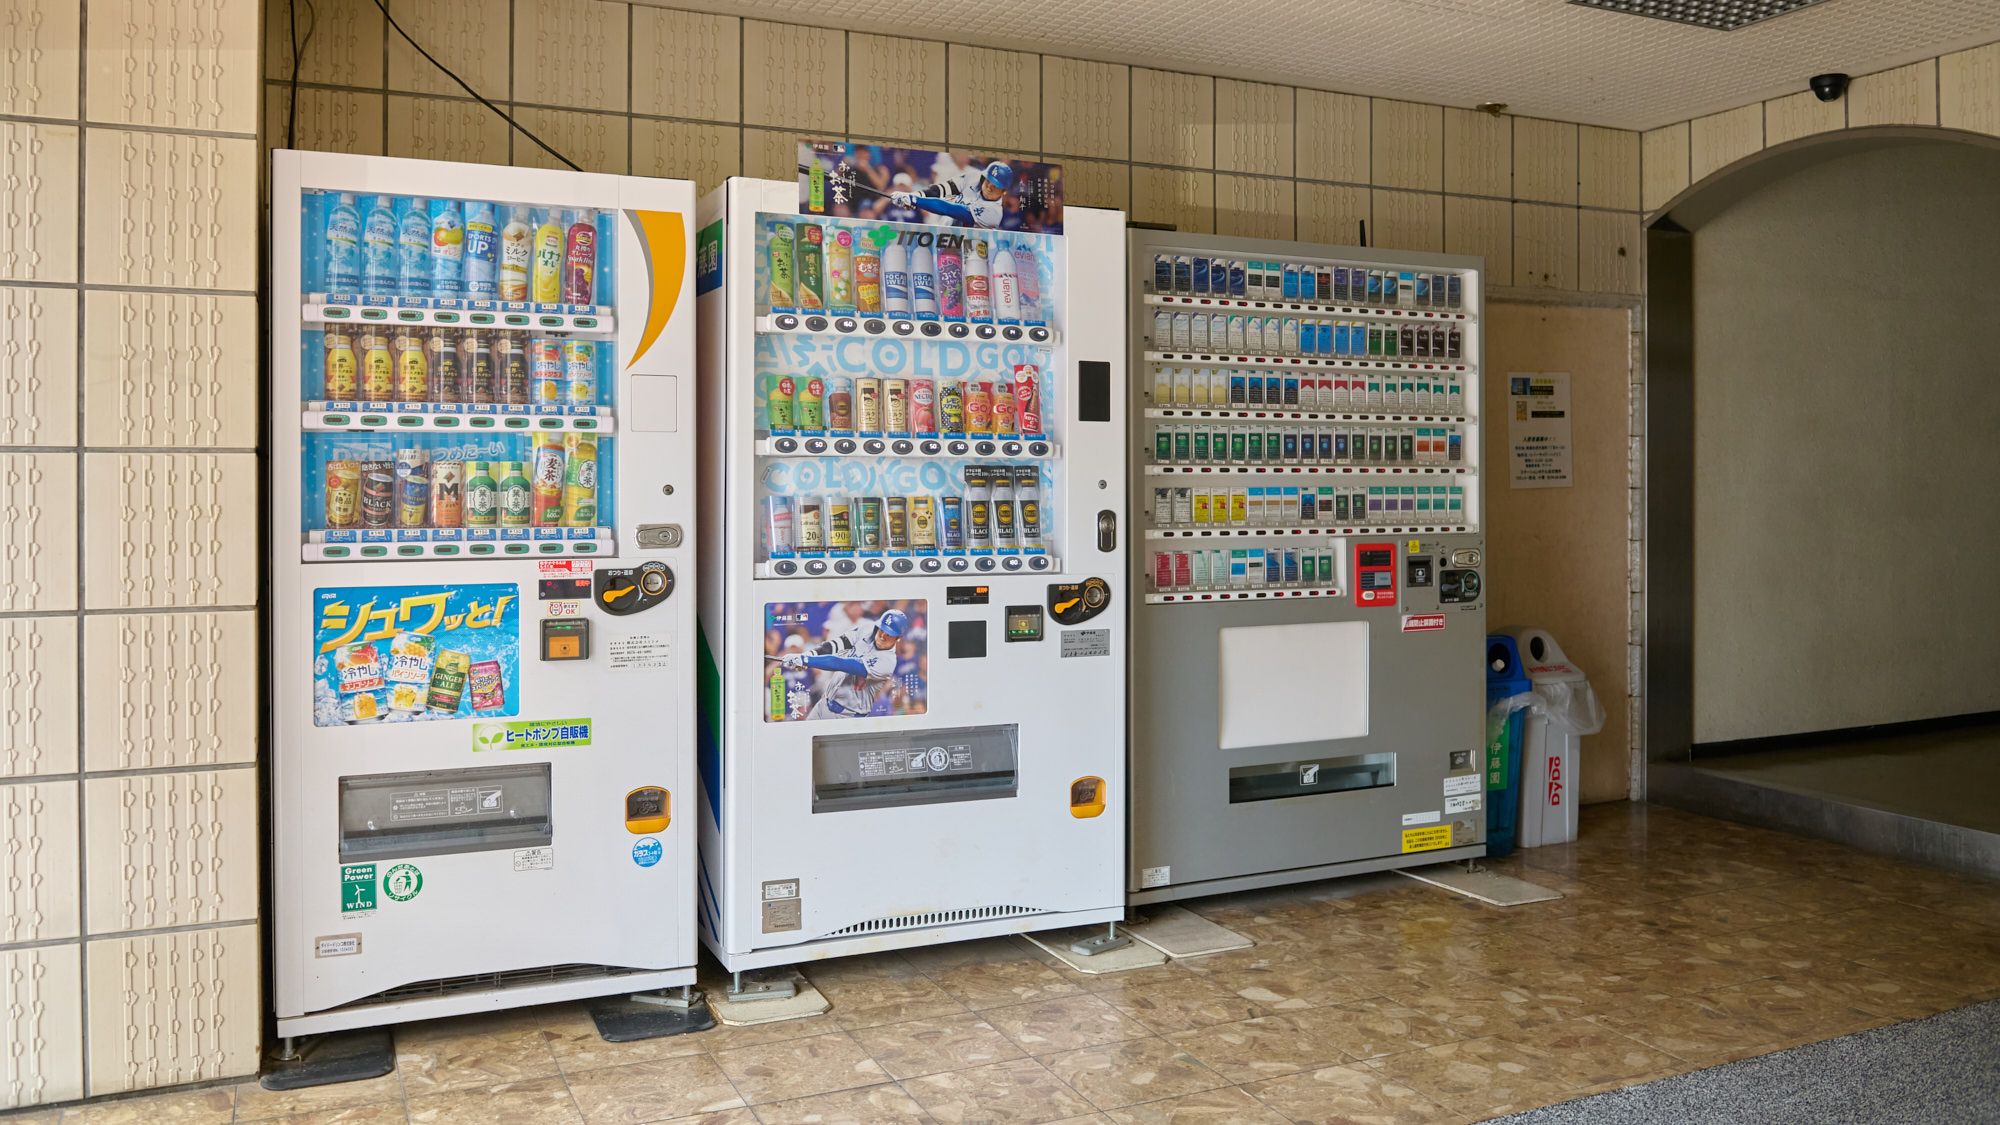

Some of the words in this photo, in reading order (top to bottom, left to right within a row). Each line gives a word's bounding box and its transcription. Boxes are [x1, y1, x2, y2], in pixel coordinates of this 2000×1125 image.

[897, 231, 935, 247] ITO
[936, 233, 965, 249] EN
[468, 241, 489, 255] UP
[506, 246, 528, 257] ミルク
[537, 248, 561, 262] バナナ
[1014, 249, 1037, 262] evian
[1002, 278, 1012, 304] evian
[363, 496, 391, 508] BLACK
[806, 531, 818, 540] 20
[835, 531, 846, 540] 90
[393, 655, 429, 671] 冷やし
[344, 664, 378, 680] 冷やし
[435, 672, 463, 683] GINGER
[440, 681, 456, 689] ALE
[506, 725, 589, 742] ヒートポンプ自販機
[1490, 742, 1501, 784] 伊藤園
[344, 873, 374, 881] Power
[345, 867, 373, 875] Green
[346, 901, 373, 909] WIND
